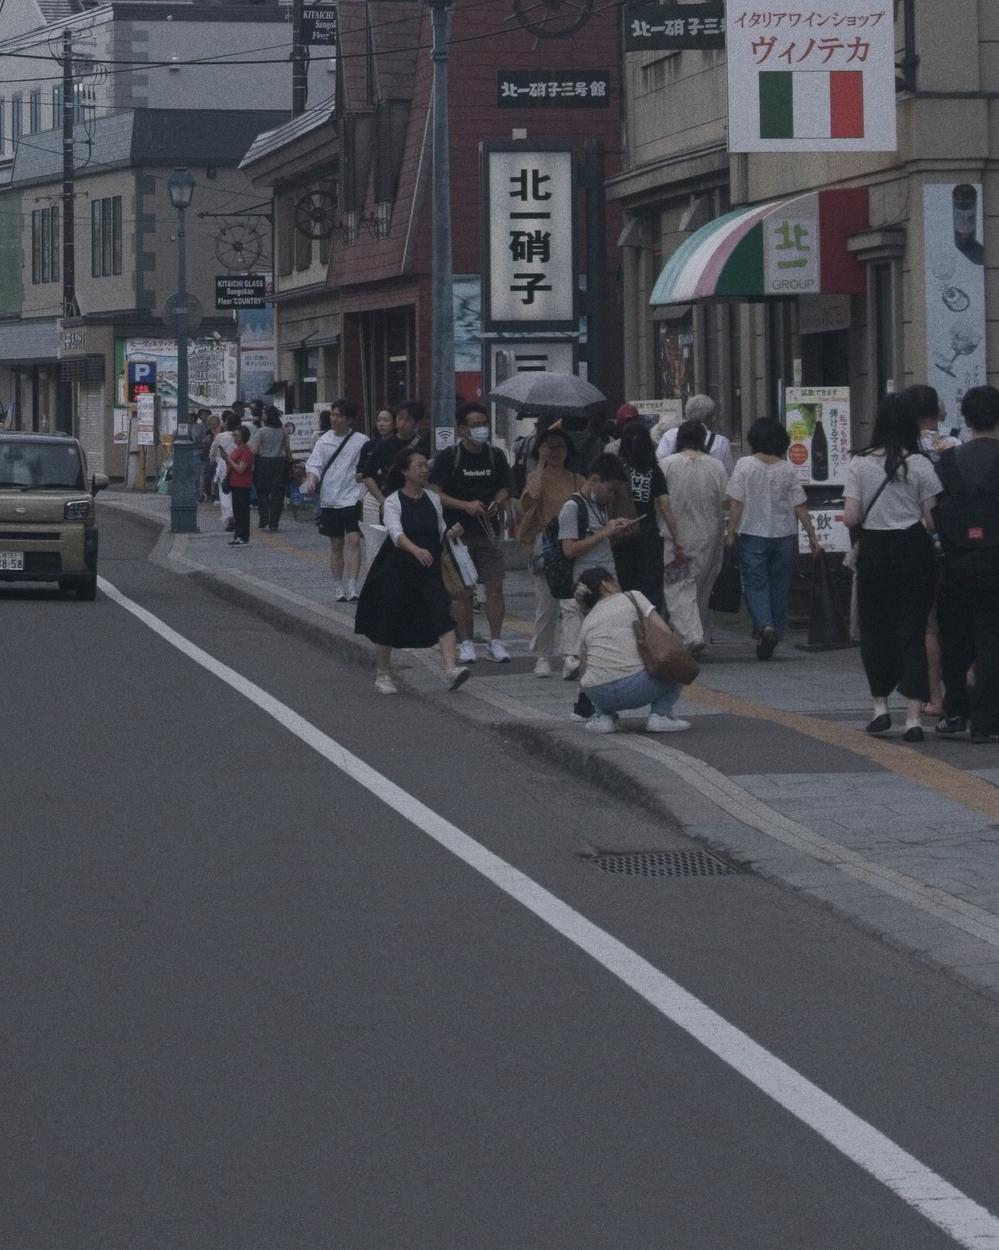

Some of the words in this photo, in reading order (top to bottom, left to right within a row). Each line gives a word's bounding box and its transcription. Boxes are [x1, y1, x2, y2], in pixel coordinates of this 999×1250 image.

[303, 10, 334, 19] KITAICHI
[734, 11, 885, 28] イタリアワインショップ
[750, 36, 871, 65] ヴィノテカ
[500, 81, 606, 97] 北一硝子三号館
[509, 168, 553, 305] 北一硝子
[774, 220, 811, 269] 北一
[218, 280, 243, 288] KITAICHI
[244, 280, 264, 288] GLASS
[772, 279, 815, 290] GROUP
[227, 288, 254, 297] Sangokan
[134, 364, 150, 382] P
